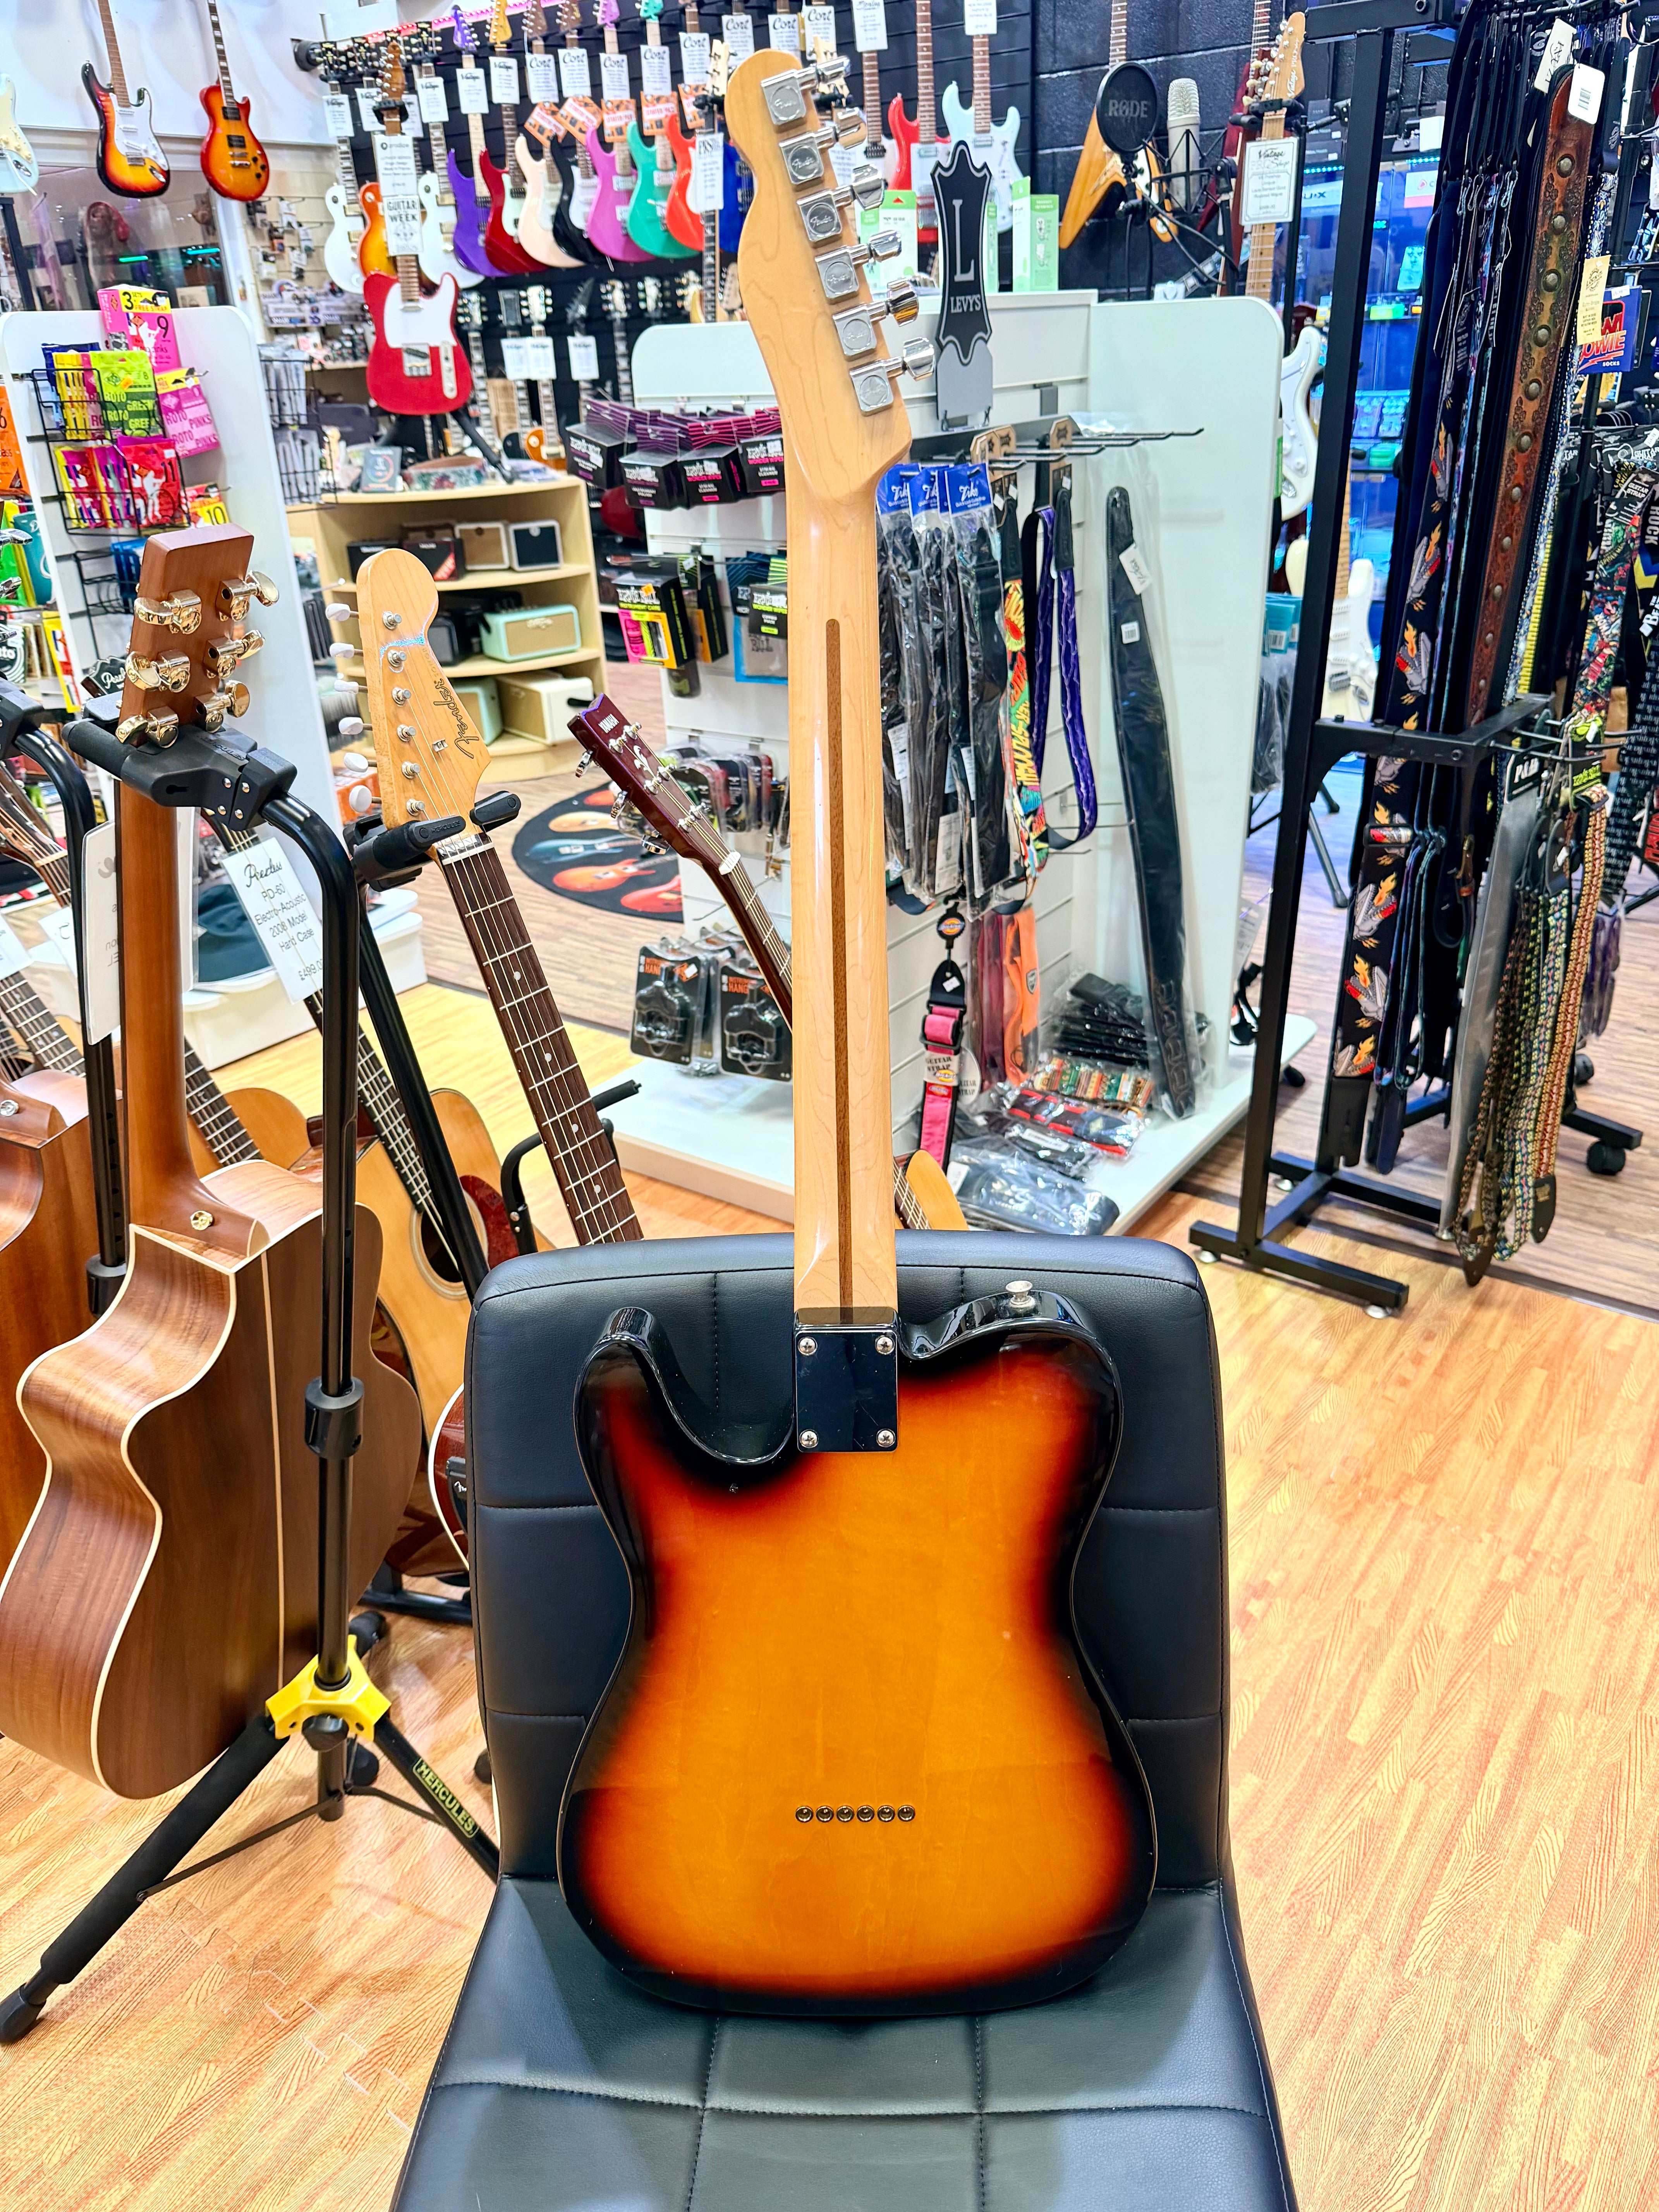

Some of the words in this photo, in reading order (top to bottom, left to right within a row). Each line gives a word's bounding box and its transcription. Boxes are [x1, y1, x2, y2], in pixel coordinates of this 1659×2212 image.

[808, 9, 831, 22] Cort
[726, 18, 749, 31] Cort
[773, 17, 796, 30] Cort
[684, 36, 706, 49] Cort
[563, 52, 585, 64] Cort
[644, 48, 666, 60] Cort
[529, 57, 552, 69] Cort
[603, 57, 625, 69] Cort
[1286, 69, 1298, 98] Vintage
[1109, 99, 1148, 118] RØDE
[1258, 148, 1285, 159] Vintage
[792, 158, 814, 169] Fender
[810, 215, 833, 227] Fender
[952, 199, 975, 282] L
[122, 291, 134, 310] 3
[157, 315, 169, 338] 9
[105, 392, 127, 402] ROTO
[189, 414, 212, 429] PINKS
[194, 434, 218, 448] PINKS
[161, 460, 175, 483] 11
[1626, 488, 1646, 499] STRAP
[1628, 482, 1649, 494] GUITAR
[207, 506, 227, 526] 10
[1645, 505, 1659, 546] ROCK
[433, 678, 479, 759] Fender
[598, 713, 619, 734] YAMAHA
[244, 857, 283, 888] Peerless
[261, 883, 286, 902] PD-60
[254, 892, 307, 926] Electro-Acoustic
[289, 909, 309, 928] Model
[278, 935, 297, 953] Hand
[296, 927, 315, 943] Case
